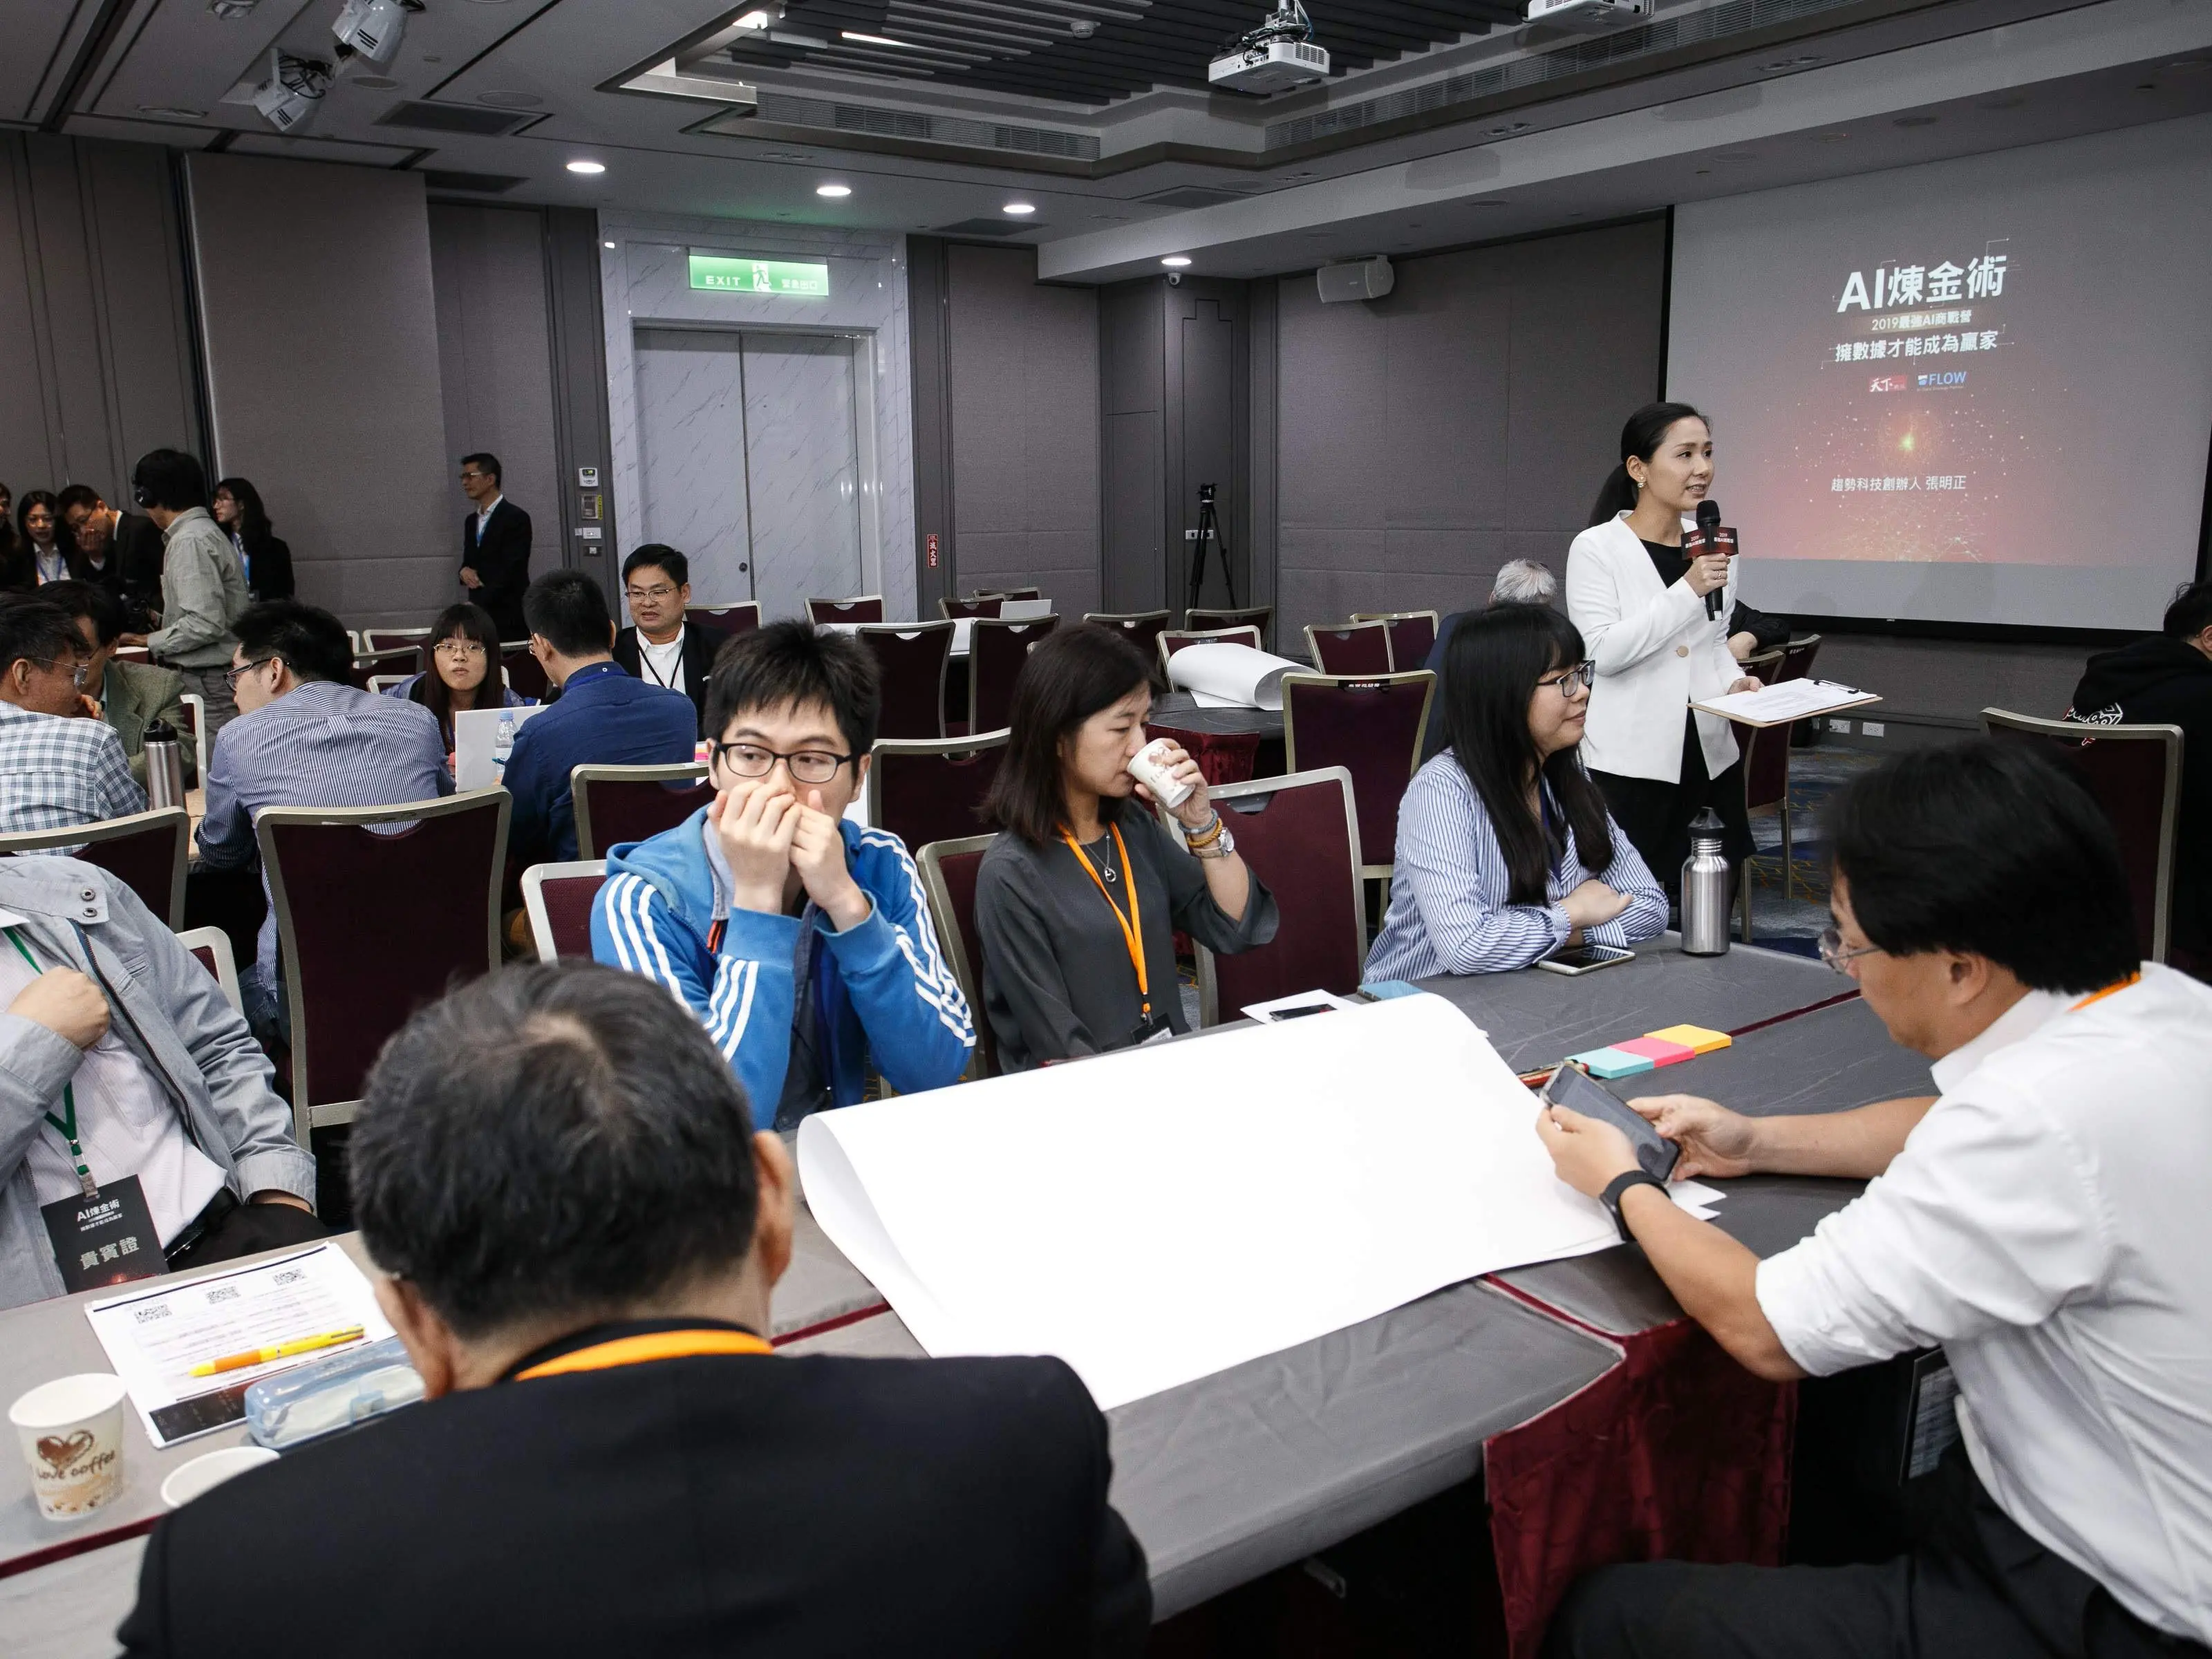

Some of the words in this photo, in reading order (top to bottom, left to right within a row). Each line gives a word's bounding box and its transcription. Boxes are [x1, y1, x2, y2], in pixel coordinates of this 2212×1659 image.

[706, 275, 741, 286] EXIT
[1837, 255, 2007, 312] AI煉金術
[1928, 371, 1967, 386] FLOW
[1926, 475, 1967, 490] 張明正
[79, 1236, 140, 1270] 貴賓證
